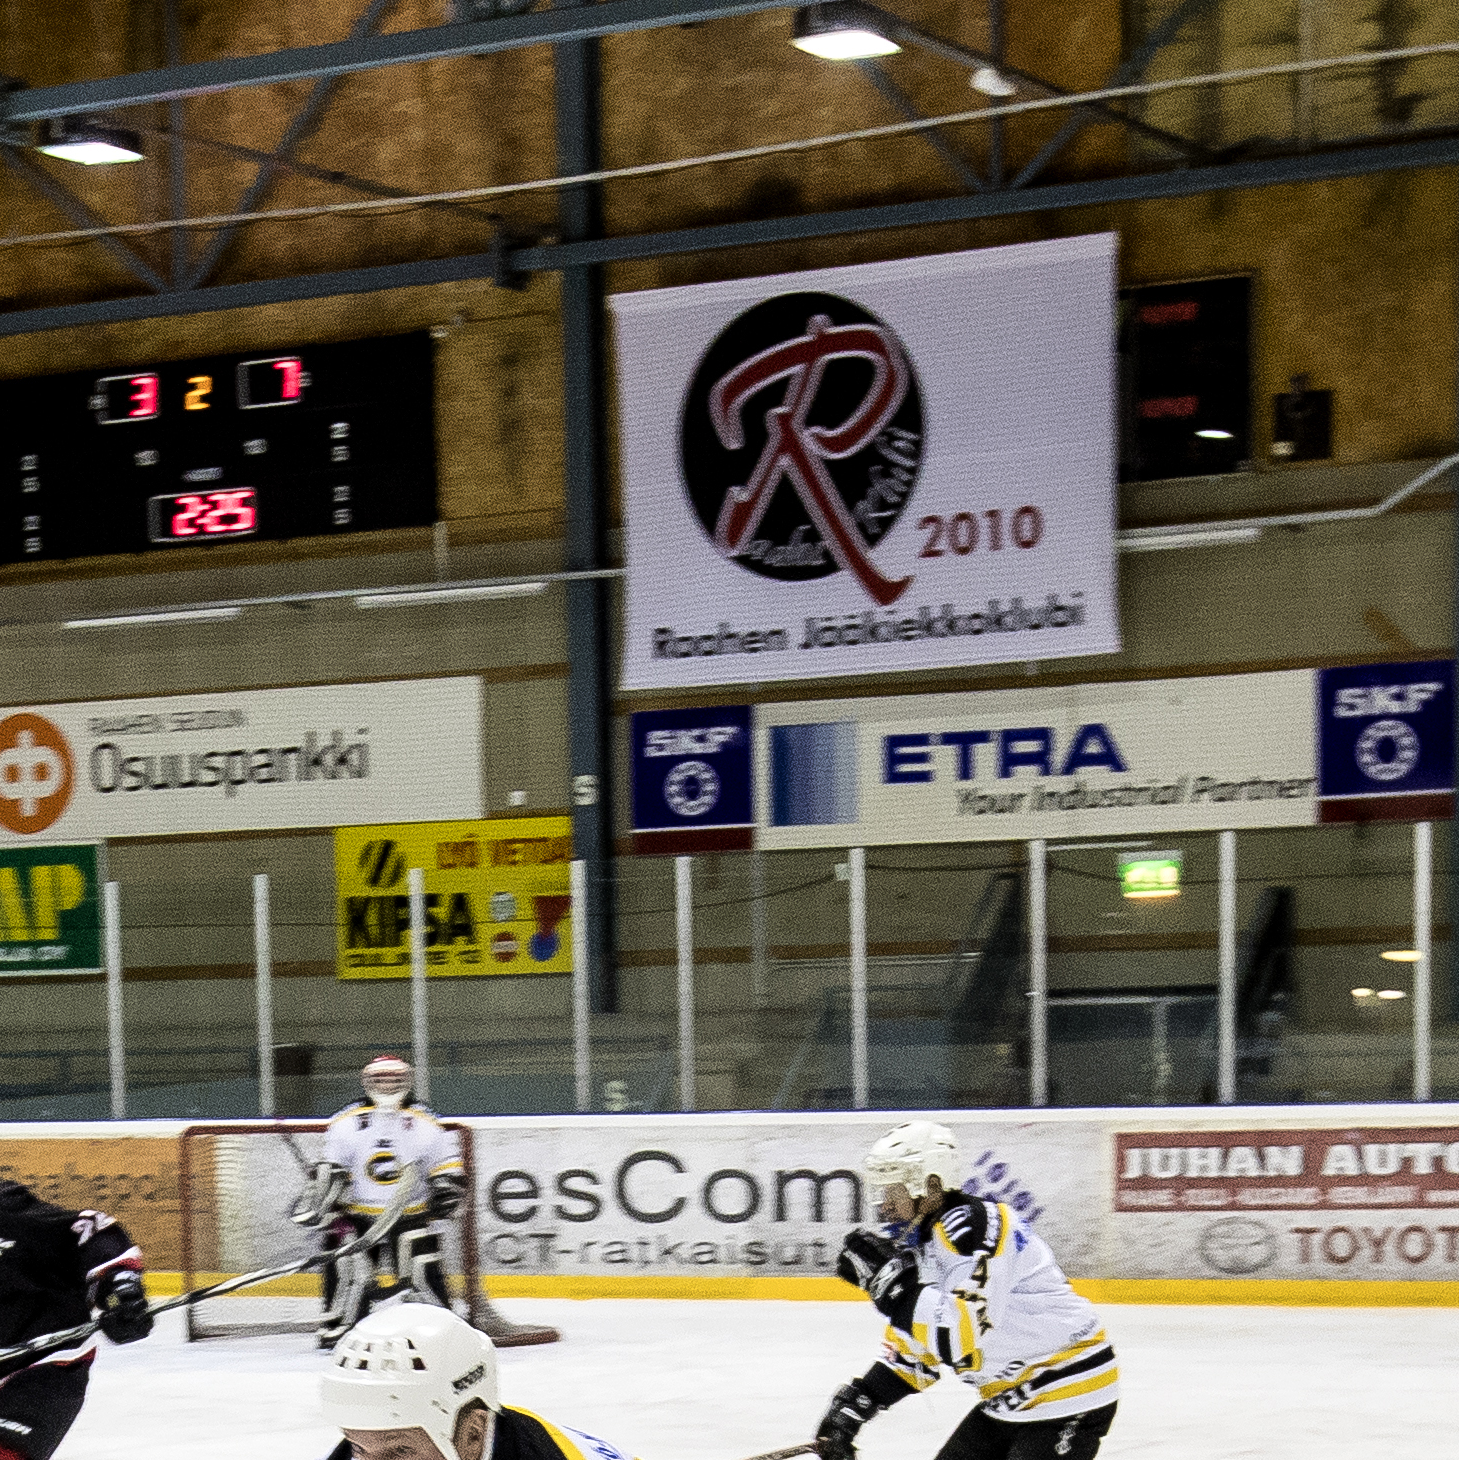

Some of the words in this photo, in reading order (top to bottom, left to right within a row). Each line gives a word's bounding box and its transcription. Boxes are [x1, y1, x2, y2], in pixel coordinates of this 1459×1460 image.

[128, 376, 159, 418] 3
[184, 375, 213, 411] 2
[917, 505, 1044, 558] 2010
[652, 622, 790, 660] Raahen
[798, 591, 1087, 651] Jääkiekkoklubi
[1332, 681, 1445, 717] SKF
[643, 725, 742, 757] SKF
[882, 721, 1128, 786] ETRA
[89, 727, 369, 798] Osuuspankki
[1120, 1146, 1305, 1179] JUHAN
[486, 1149, 865, 1225] esCom
[485, 1230, 830, 1269] CT-ratkaisut
